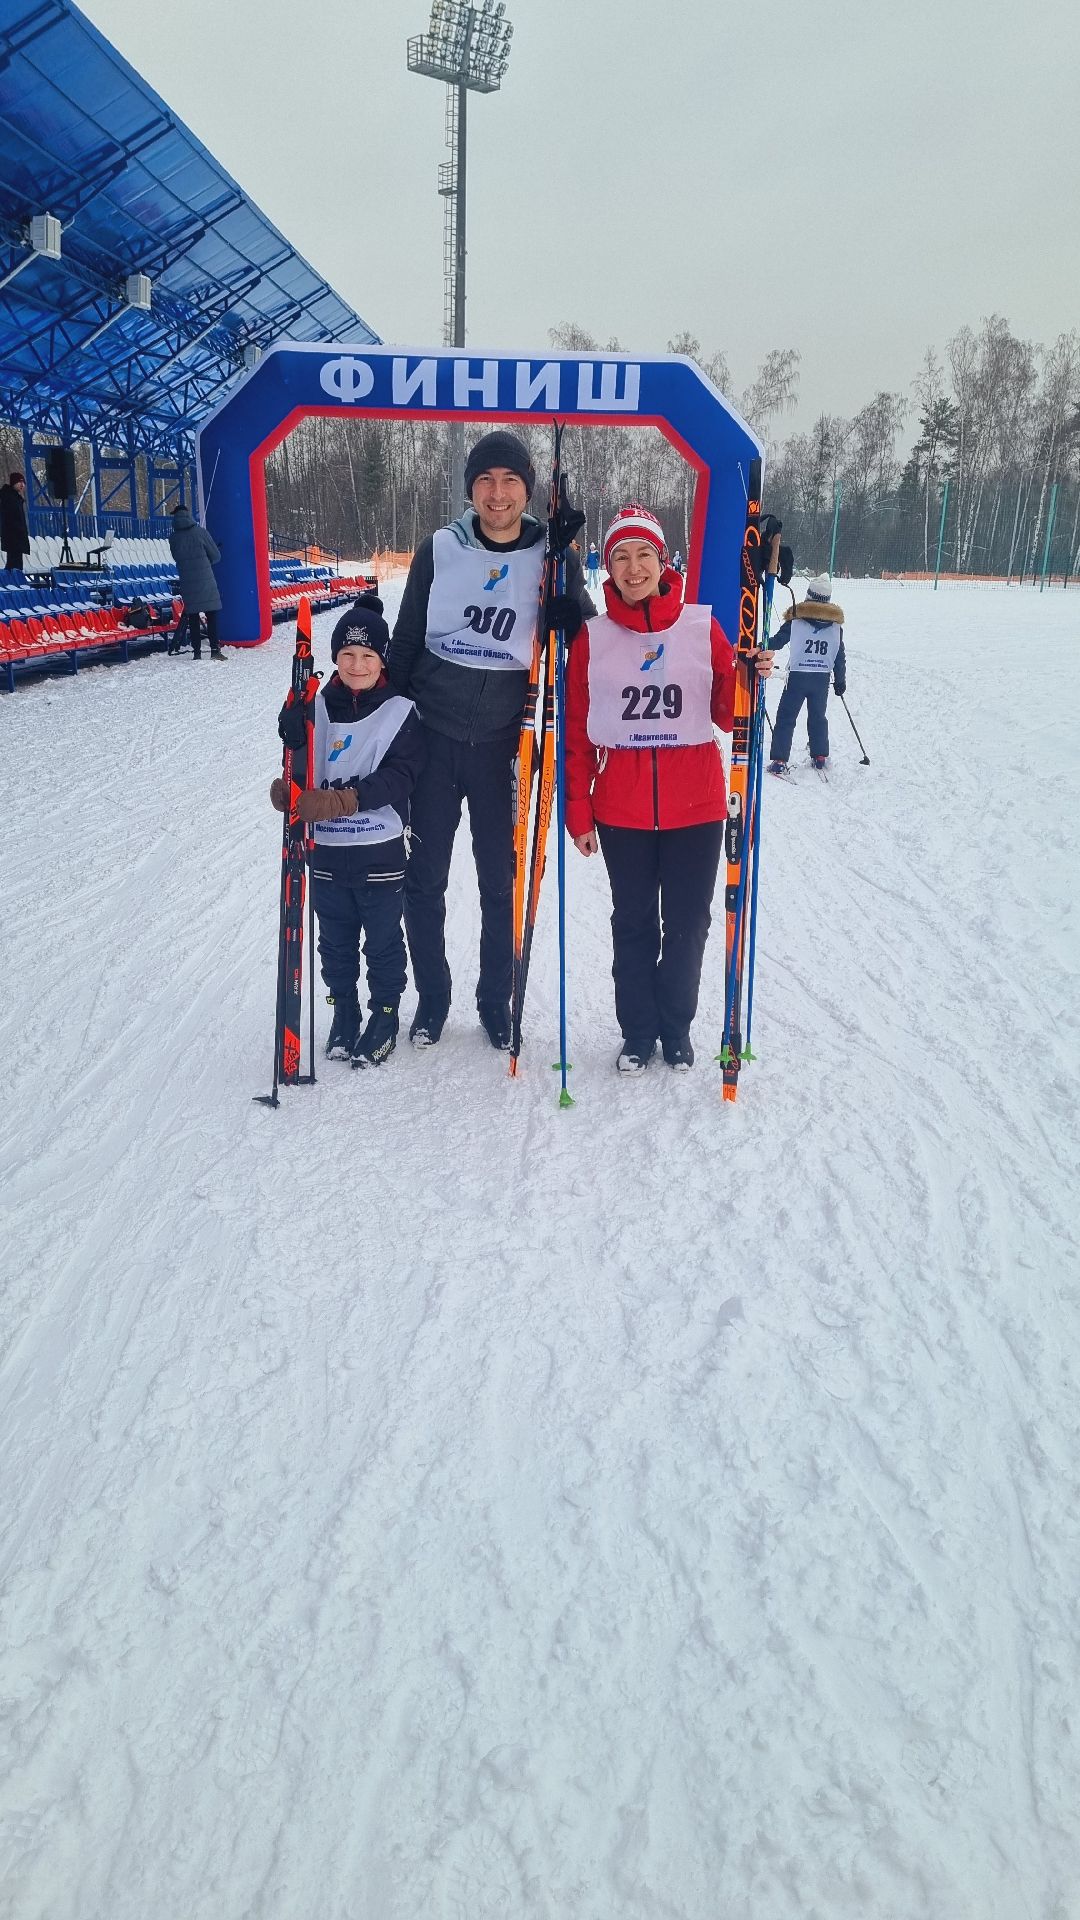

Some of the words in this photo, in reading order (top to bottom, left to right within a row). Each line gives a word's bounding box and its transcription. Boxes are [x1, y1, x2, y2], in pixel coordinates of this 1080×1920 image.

[319, 355, 641, 411] ФИНИШ
[804, 639, 829, 656] 218
[621, 683, 683, 721] 229
